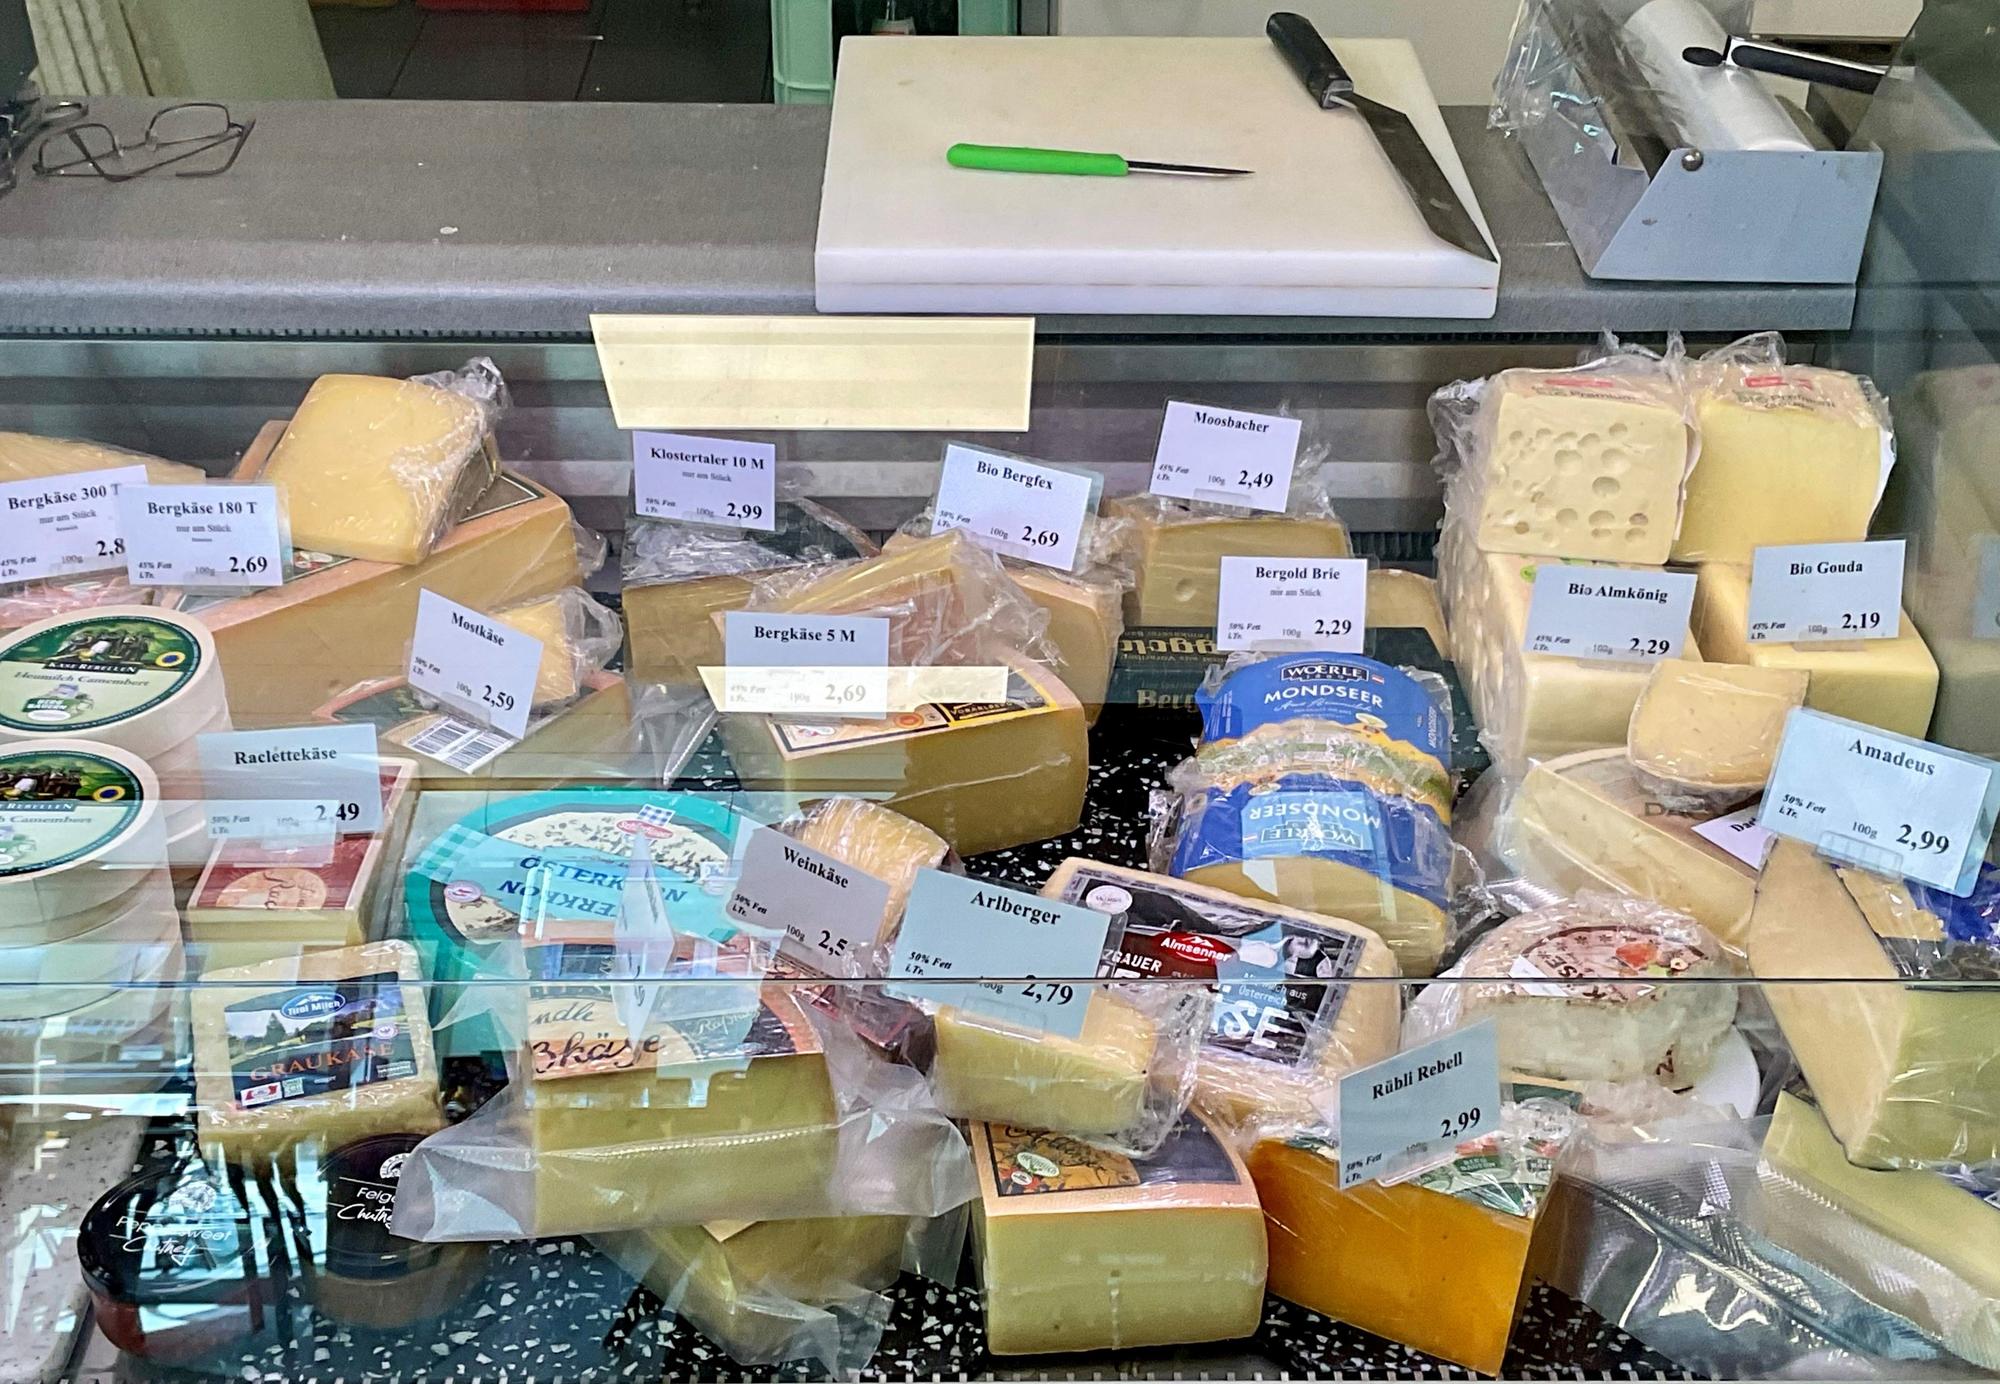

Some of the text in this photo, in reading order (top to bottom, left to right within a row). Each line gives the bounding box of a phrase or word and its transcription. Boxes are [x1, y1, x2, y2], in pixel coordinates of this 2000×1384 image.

[1193, 411, 1270, 433] Moosbacher
[650, 447, 764, 470] Klostertaler 10 M
[976, 461, 1053, 490] Bio Bergfex
[1175, 466, 1190, 474] Fett
[1208, 470, 1274, 489] 100g 2,49
[8, 483, 122, 511] Bergkäse 300 T
[147, 501, 258, 517] Bergkäse 180 T
[696, 502, 762, 520] 100g 2,99
[990, 526, 1060, 548] 100g 2,69
[61, 537, 126, 564] 100g 2,8
[156, 561, 173, 569] Fett
[195, 555, 269, 577] 100g 2,69
[1255, 566, 1341, 583] Bergold Brie
[1790, 560, 1863, 576] Bio Gouda
[1568, 583, 1669, 604] Bio Almkönig
[452, 612, 505, 646] Mostkäse
[754, 625, 856, 643] Bergkäse 5 M
[1282, 619, 1352, 638] 100g 2,29
[1770, 621, 1786, 630] Fett
[1808, 612, 1881, 635] 100g 2,19
[1554, 636, 1571, 644] Fett
[1592, 637, 1671, 657] 100g 2,29
[1286, 663, 1363, 678] WOERLE
[456, 681, 515, 711] 100g 2,59
[825, 683, 867, 704] 2,69
[1263, 685, 1384, 709] MONDSEER
[234, 747, 338, 765] Raclettekäse
[1848, 738, 1936, 776] Amadeus
[314, 802, 360, 824] 2,49
[1782, 793, 1827, 814] 50% Fett
[1249, 802, 1382, 830] MONDSEER
[1269, 827, 1357, 845] WORLE
[1851, 820, 1951, 856] 100g 2,99
[783, 846, 849, 889] Weinkäse
[735, 893, 768, 915] 50% Fett
[970, 891, 1061, 925] Arlberger
[786, 923, 849, 957] 100g 2,5
[1160, 937, 1232, 963] Almsenner
[908, 951, 953, 970] 50% Fett
[1022, 975, 1074, 1006] 2,79
[1238, 984, 1288, 1007] Österreich
[1289, 989, 1308, 1000] aus
[287, 1000, 341, 1017] Tirol Milch
[1372, 1051, 1463, 1100] Rübli Rebell
[1441, 1107, 1481, 1139] 2,99
[1346, 1153, 1382, 1173] 50% Fett
